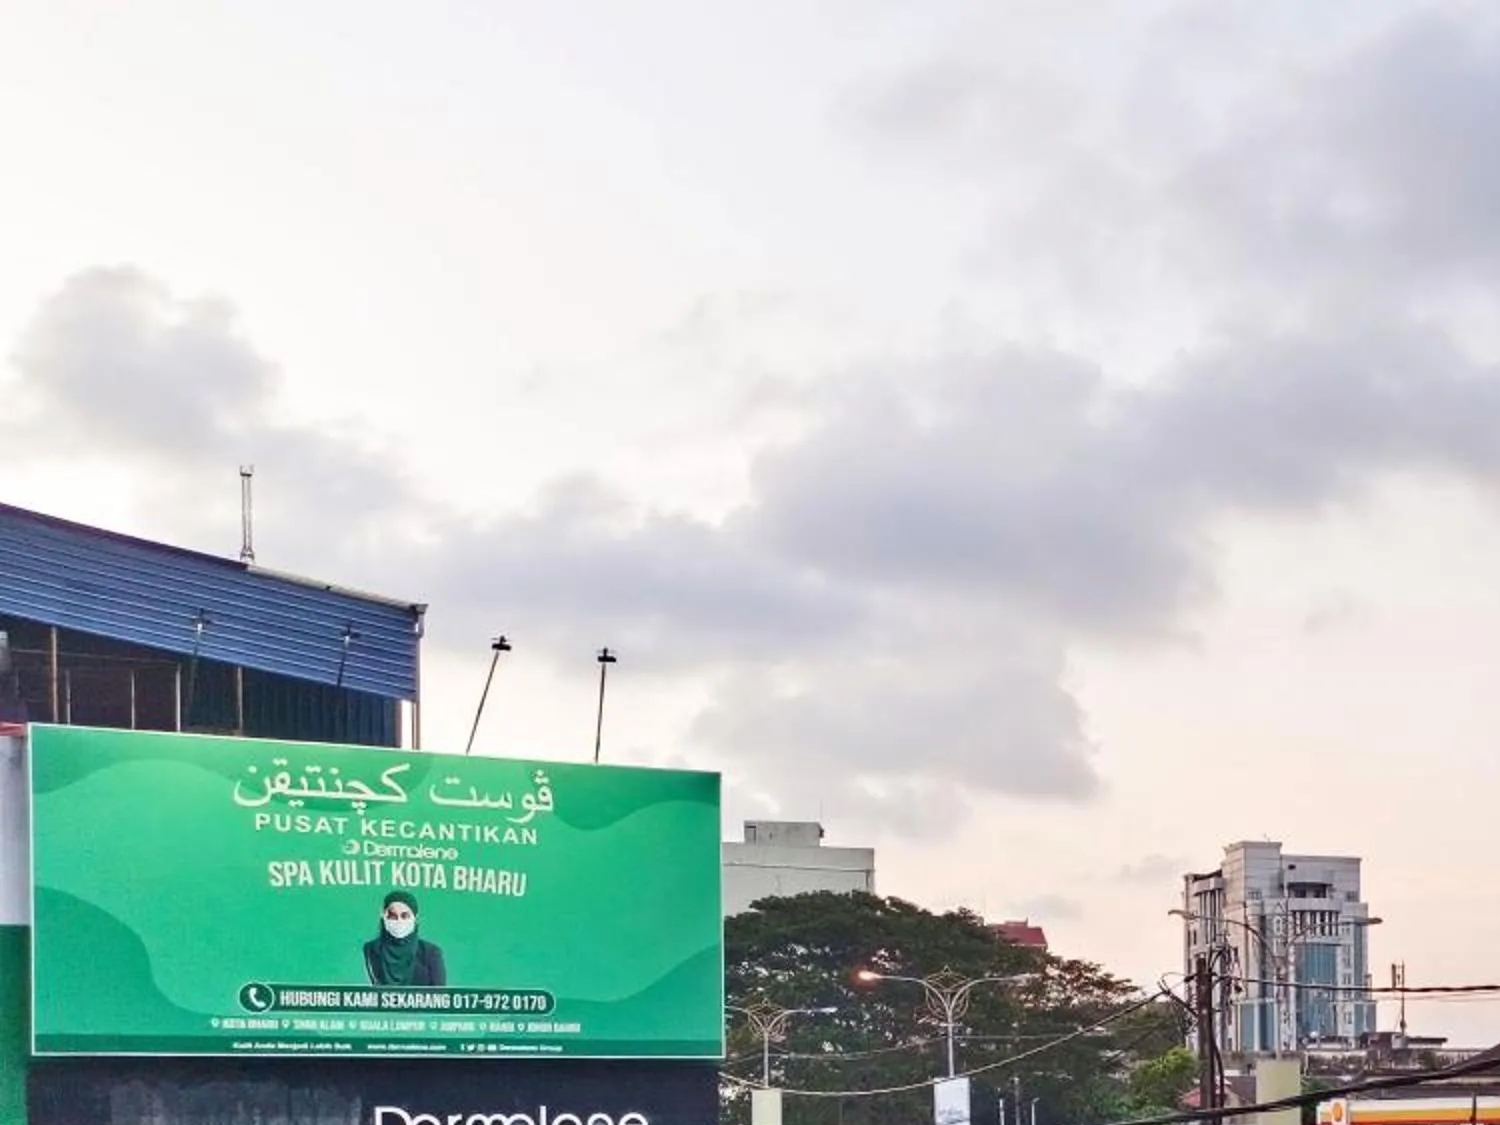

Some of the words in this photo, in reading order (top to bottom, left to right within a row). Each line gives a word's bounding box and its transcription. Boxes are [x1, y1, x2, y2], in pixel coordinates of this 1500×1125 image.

[429, 769, 553, 823] ڤوست
[255, 813, 349, 835] PUSAT
[361, 818, 537, 845] KECANTIKAN
[364, 840, 458, 860] Dermalene
[268, 861, 314, 887] SPA
[319, 860, 384, 885] KULIT
[391, 861, 447, 889] KOTA
[453, 865, 527, 897] BHARU
[280, 990, 340, 1007] HUBUNGI
[343, 991, 378, 1007] KAMI
[381, 992, 450, 1009] SEKARANG
[453, 993, 510, 1010] 017-972
[512, 995, 547, 1011] 0170
